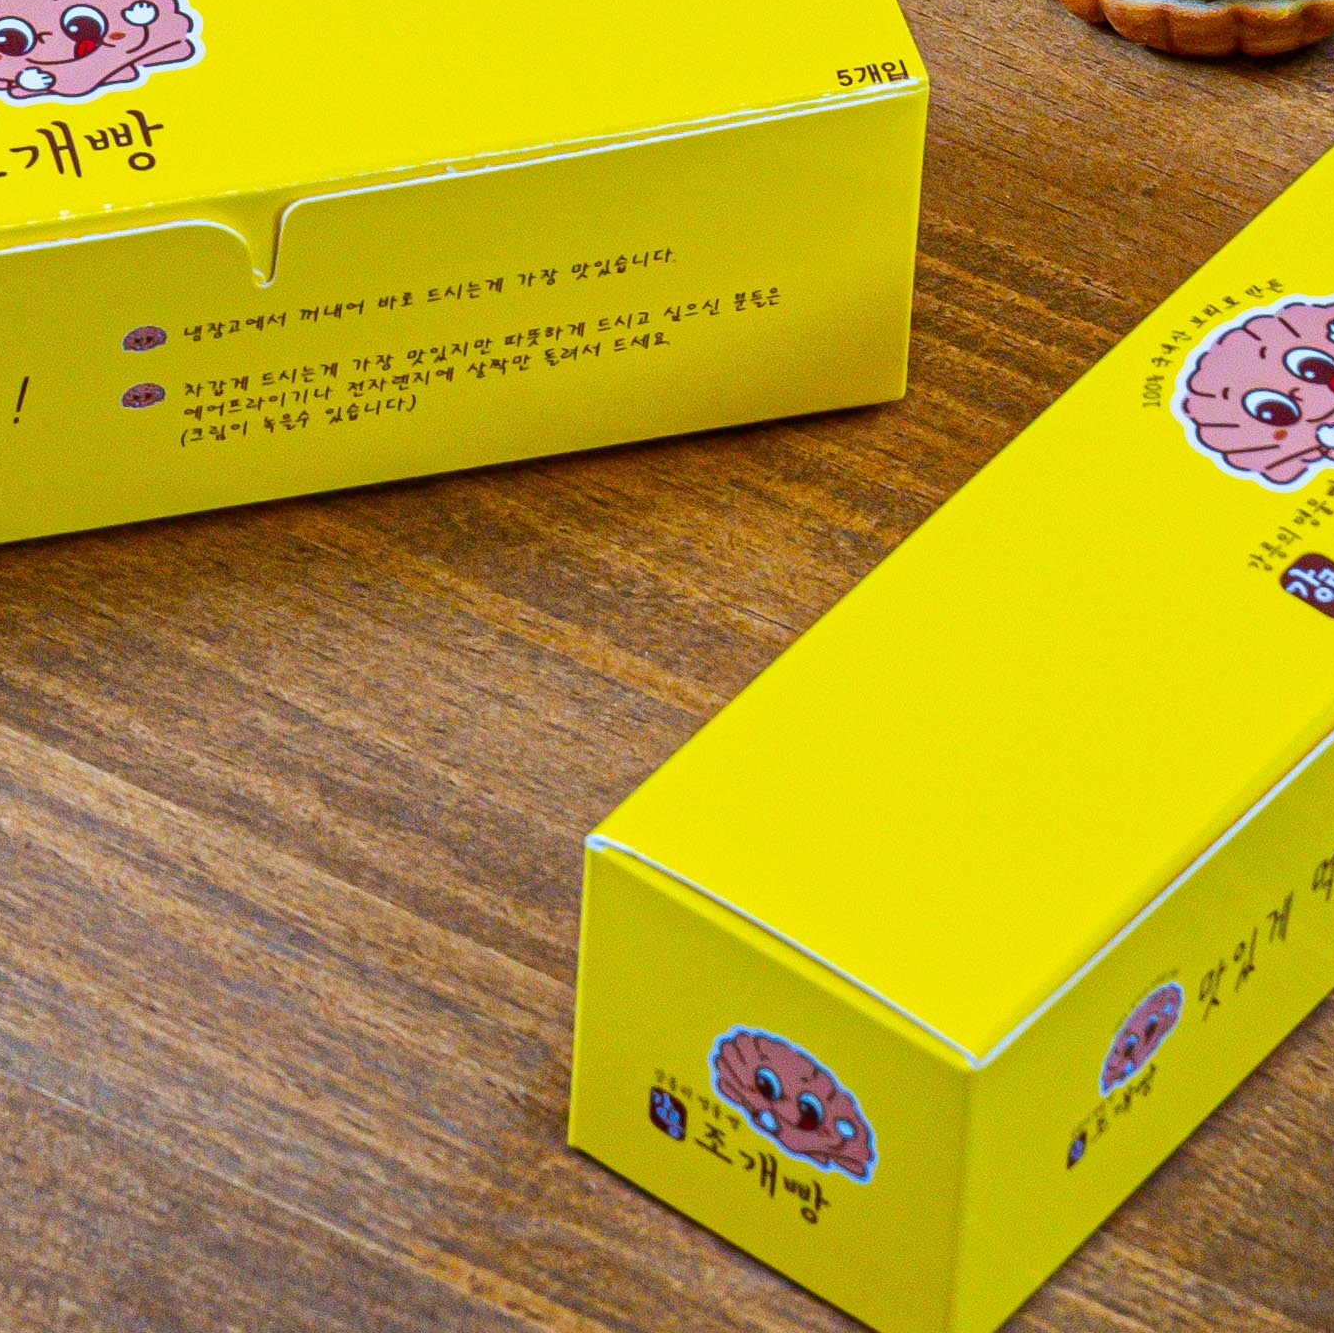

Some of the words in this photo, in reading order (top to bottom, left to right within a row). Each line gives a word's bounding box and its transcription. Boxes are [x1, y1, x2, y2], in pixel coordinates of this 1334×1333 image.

[837, 60, 909, 86] 5개입
[184, 312, 286, 342] 냉장고에서
[300, 300, 364, 322] 꺼내어
[378, 292, 412, 310] 바로
[428, 278, 503, 302] 드시는게
[518, 269, 557, 287] 가장
[185, 376, 249, 397] 차갑게
[262, 362, 338, 386] 드시는게
[353, 354, 393, 371] 가장
[407, 338, 492, 366] 맛있지만
[505, 322, 585, 347] 따뜻하게
[598, 312, 649, 331] 드시고
[734, 288, 780, 311] 분들은
[181, 421, 247, 447] (크림이
[325, 392, 416, 424] 있습니다.)
[184, 383, 334, 421] 에어프라이기나
[348, 367, 454, 397] 전자렌지에
[695, 1123, 830, 1224] 조개빵
